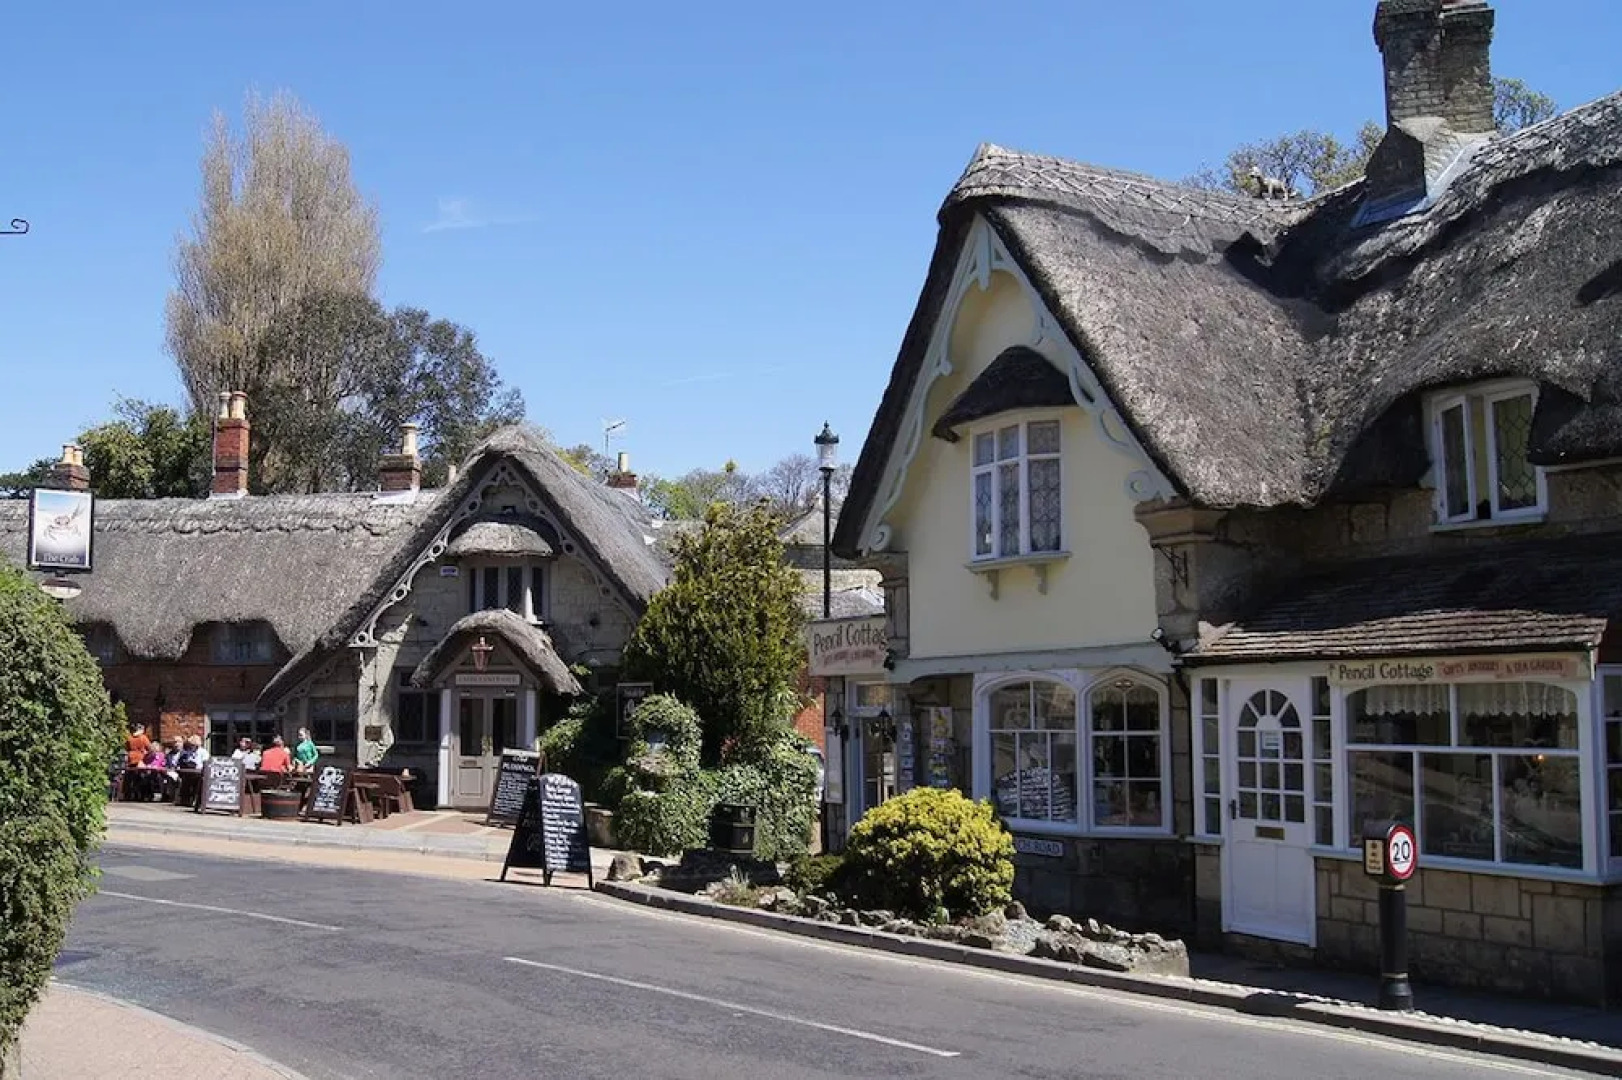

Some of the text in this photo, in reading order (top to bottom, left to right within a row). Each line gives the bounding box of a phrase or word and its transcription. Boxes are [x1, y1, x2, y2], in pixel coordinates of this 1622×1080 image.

[813, 622, 887, 656] Pencil Cottag
[1339, 662, 1433, 681] Pencil Cottage
[1033, 840, 1060, 854] ROAD
[1393, 840, 1410, 861] 20
